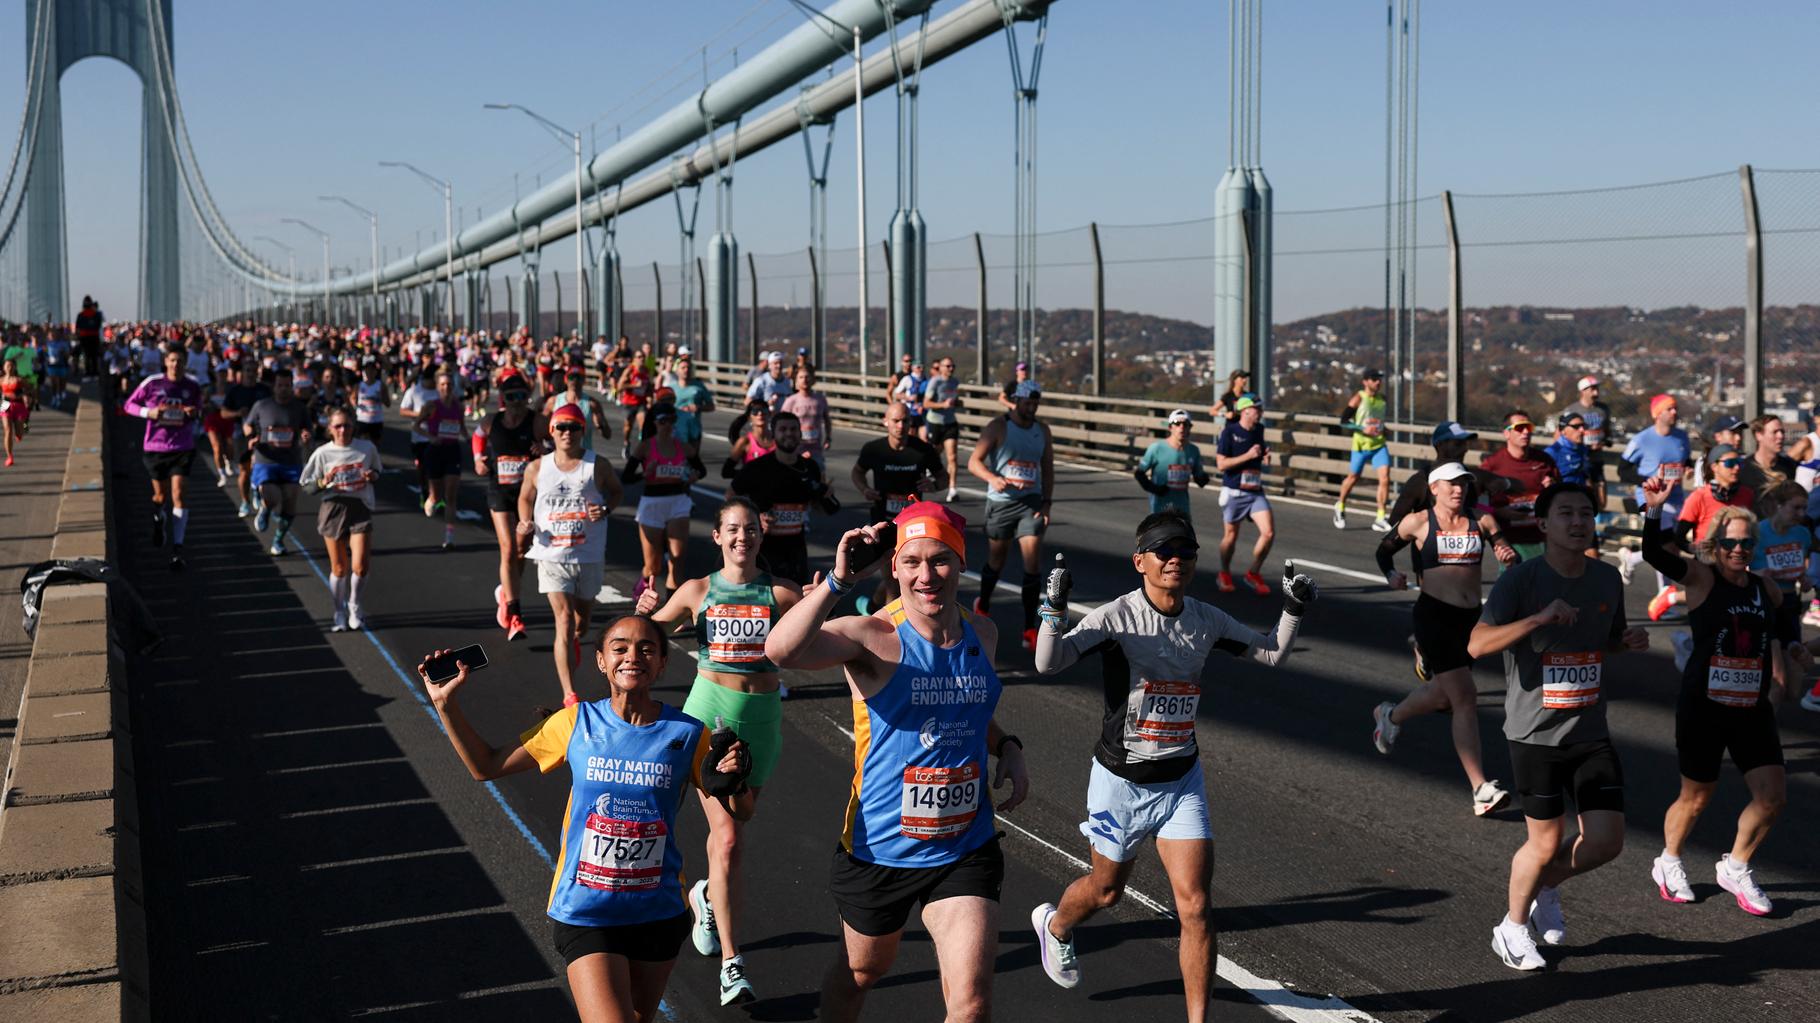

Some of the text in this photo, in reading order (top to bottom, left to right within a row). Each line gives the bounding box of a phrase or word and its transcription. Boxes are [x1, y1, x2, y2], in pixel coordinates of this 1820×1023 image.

[1727, 606, 1766, 619] VANJA
[711, 619, 765, 637] 19002
[1548, 665, 1597, 683] 17003
[1711, 670, 1760, 684] AG 3394
[911, 675, 986, 689] GRAY NATION
[911, 690, 988, 705] ENDURANCE
[1148, 696, 1194, 715] 18615
[938, 720, 969, 729] National
[938, 729, 956, 738] Brain
[937, 738, 962, 748] Society
[587, 755, 672, 776] GRAY NATION
[586, 768, 671, 789] ENDURANCE
[915, 770, 934, 782] tcs
[613, 797, 647, 807] National
[910, 782, 975, 809] 14999
[612, 805, 658, 815] Brain Tumor
[612, 813, 640, 822] Society
[595, 818, 612, 833] tcs
[592, 834, 657, 861] 17527
